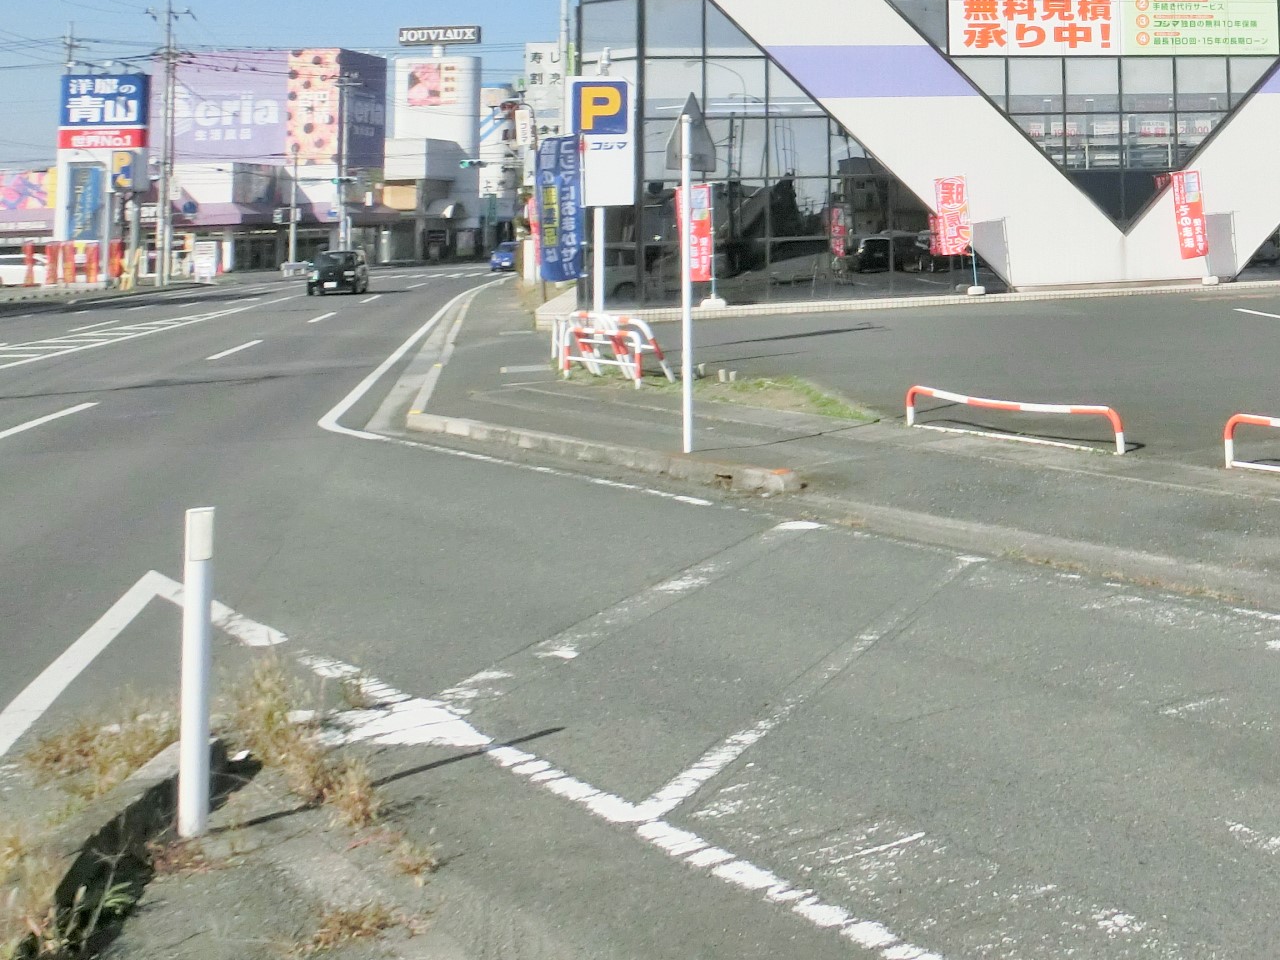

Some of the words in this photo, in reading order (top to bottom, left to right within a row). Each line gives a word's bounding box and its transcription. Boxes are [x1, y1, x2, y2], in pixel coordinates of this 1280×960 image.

[1153, 2, 1225, 11] 手続き代行サービス
[69, 78, 137, 94] 洋服の
[65, 95, 138, 122] 青山
[580, 86, 621, 130] P
[590, 141, 628, 151] コジマ
